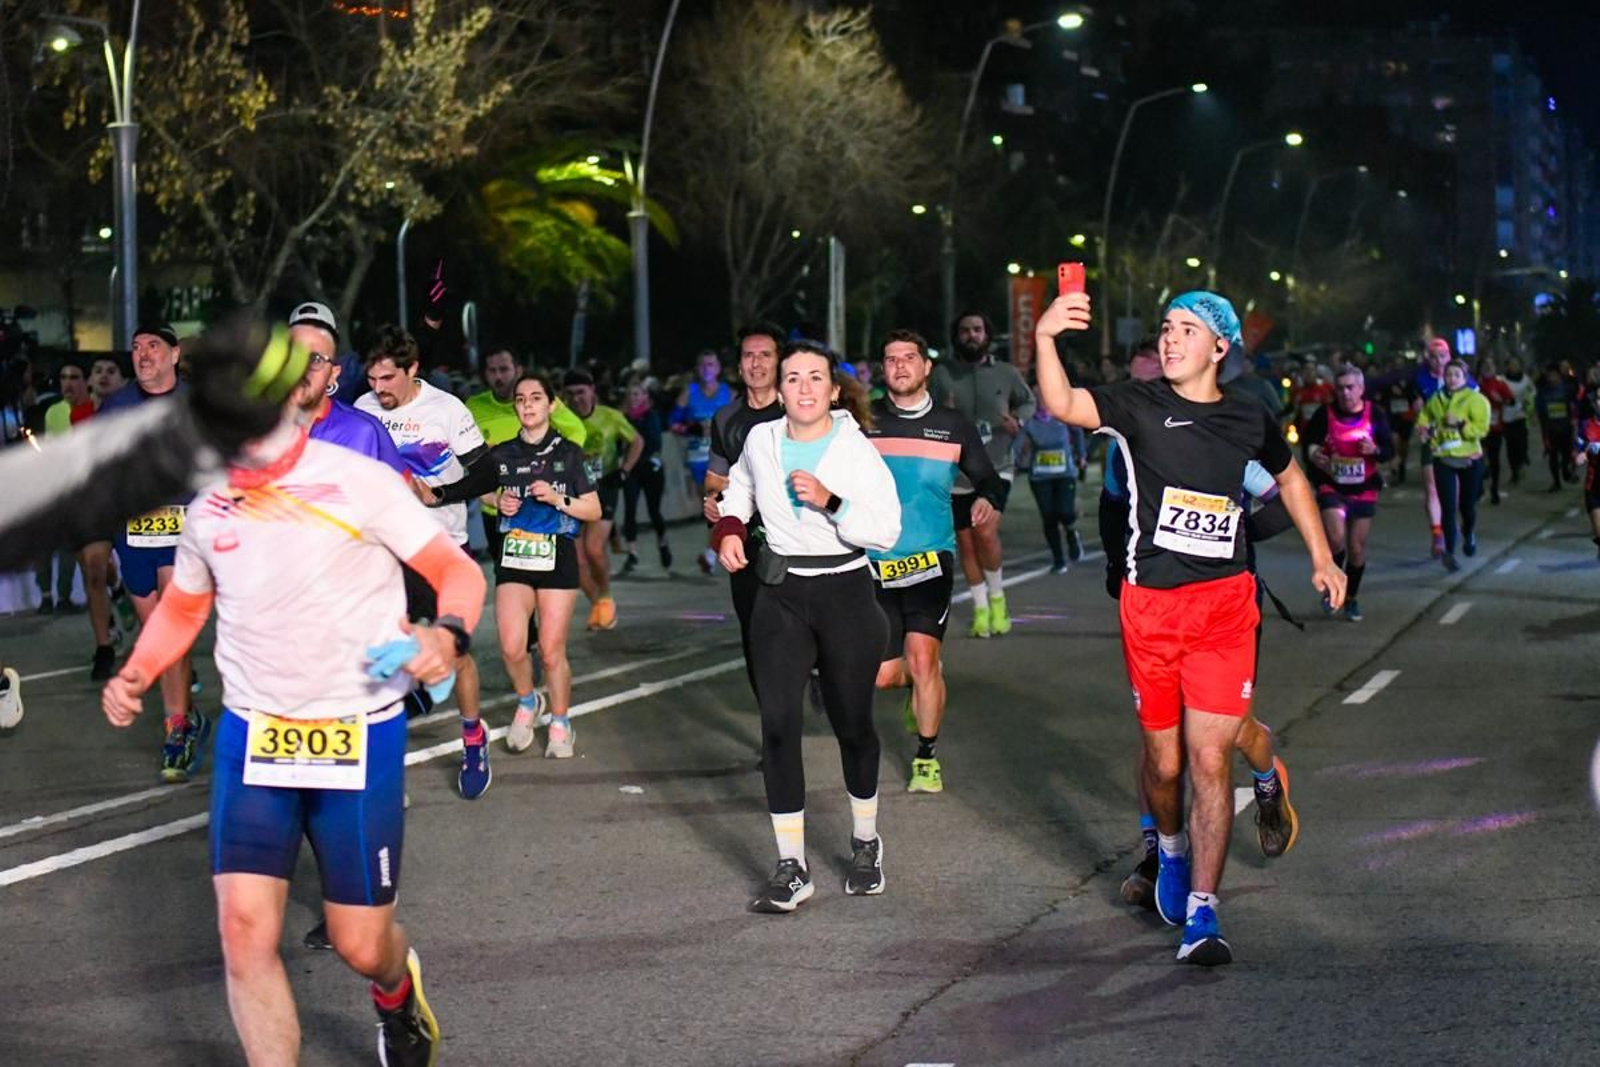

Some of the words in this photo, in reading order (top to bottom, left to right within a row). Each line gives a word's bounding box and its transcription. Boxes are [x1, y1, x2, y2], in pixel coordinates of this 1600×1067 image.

[131, 516, 179, 532] 3233
[1168, 506, 1232, 534] 7834
[507, 540, 551, 556] 2719
[886, 554, 931, 579] 3991
[260, 727, 352, 756] 3903
